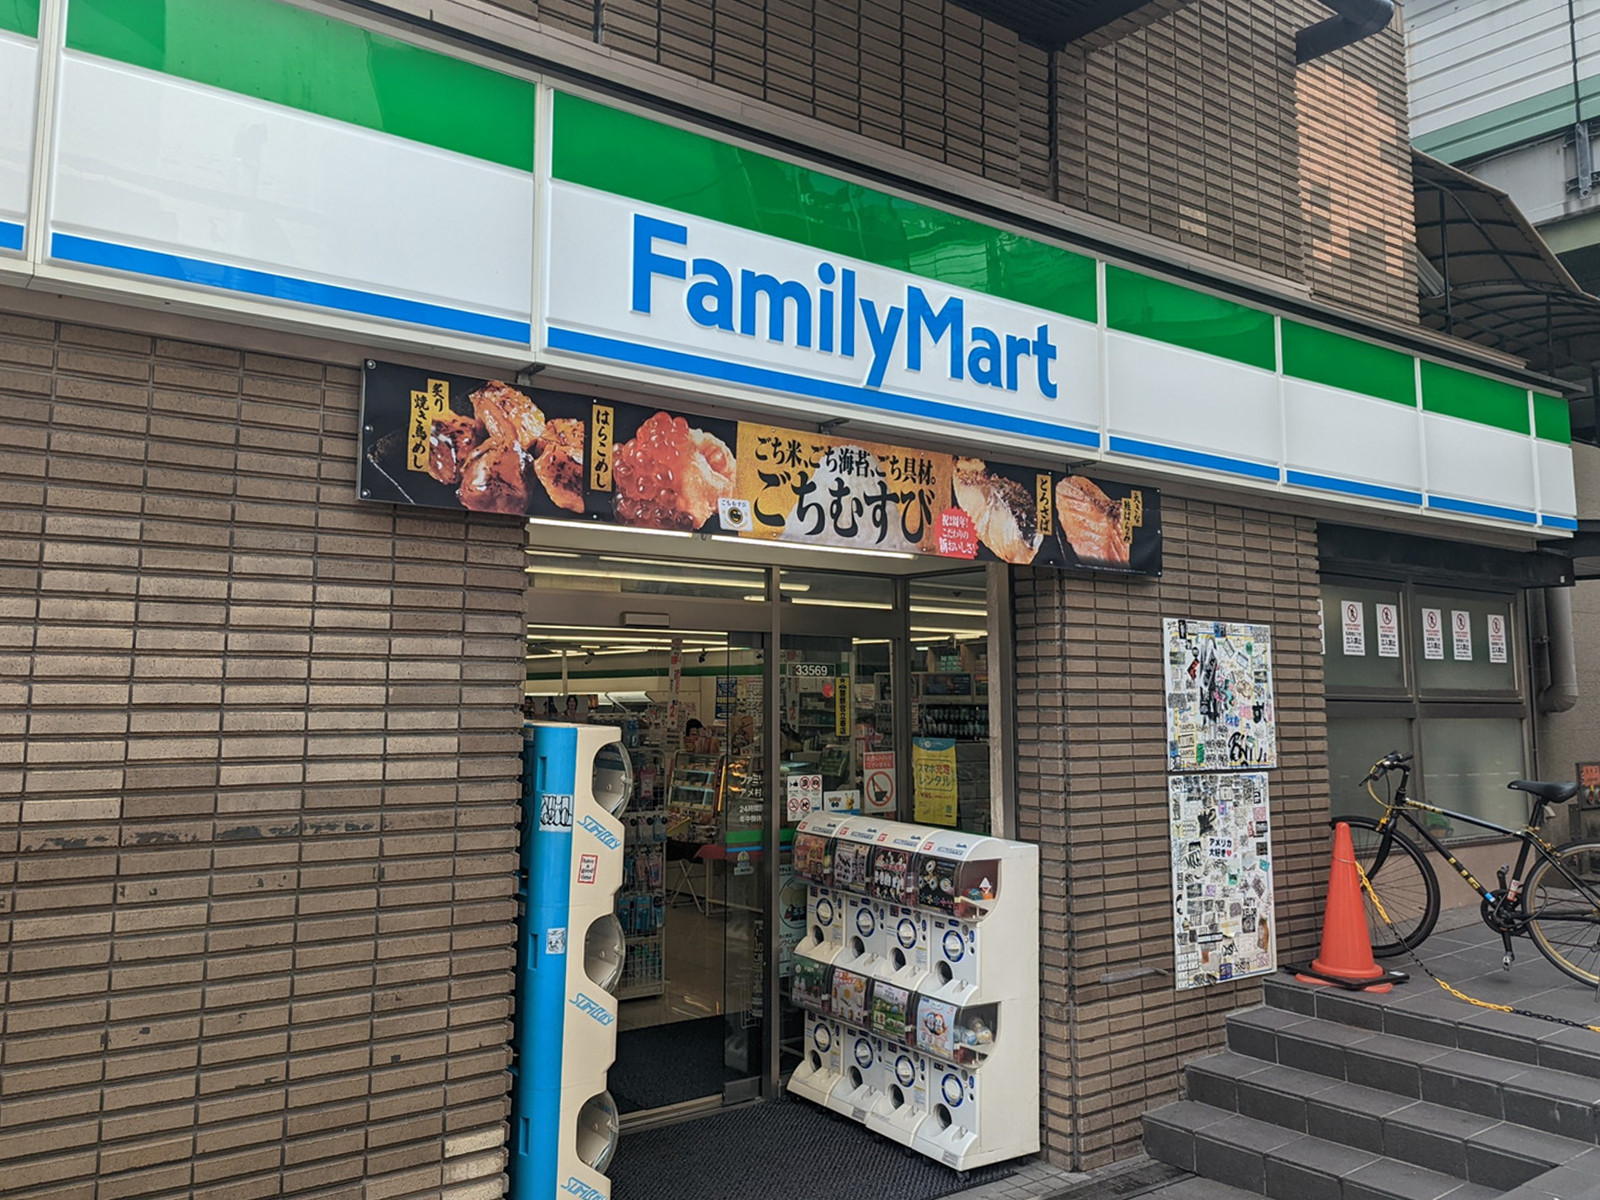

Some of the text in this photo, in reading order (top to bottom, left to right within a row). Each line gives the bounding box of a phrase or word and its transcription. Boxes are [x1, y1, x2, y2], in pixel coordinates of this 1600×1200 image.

[632, 213, 1058, 399] FamilyMart
[430, 381, 446, 413] 炙り
[411, 394, 429, 469] 焼き鳥めし
[595, 409, 611, 489] はらこめし
[755, 436, 936, 486] ごち米、ごち海苔、ごち具材。
[754, 469, 936, 545] ごちむすび
[1039, 478, 1051, 533] とろさば
[942, 527, 969, 540] こだわりの
[795, 665, 828, 676] 33569
[919, 775, 951, 787] レンタル
[1209, 838, 1233, 848] アメリカ
[1209, 848, 1227, 857] 大好き
